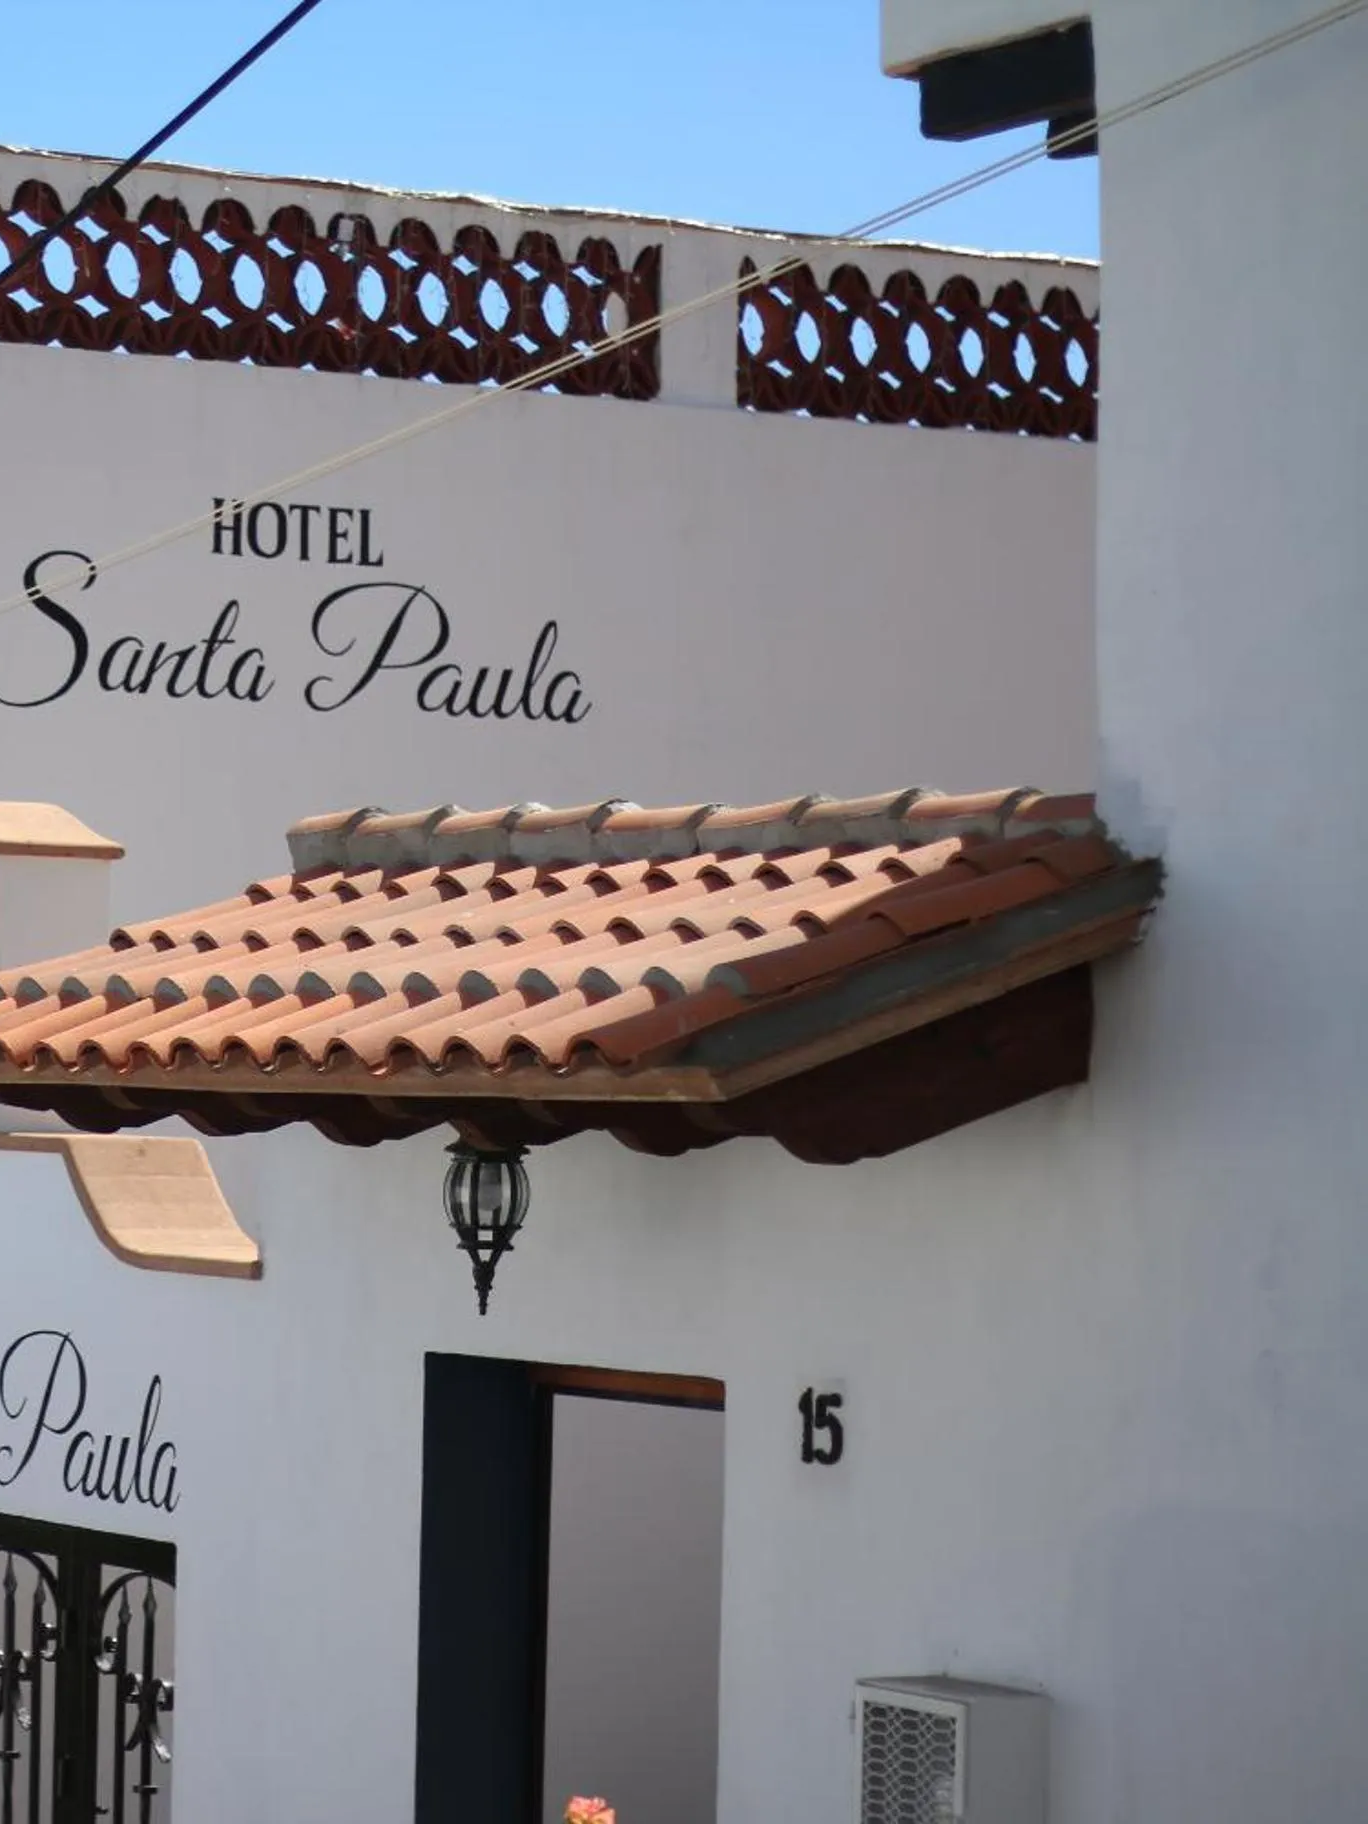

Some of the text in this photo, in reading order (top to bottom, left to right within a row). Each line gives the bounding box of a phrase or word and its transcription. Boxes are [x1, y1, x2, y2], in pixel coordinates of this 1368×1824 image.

[211, 497, 384, 567] HOTEL
[303, 582, 592, 724] Paula
[798, 1387, 843, 1465] 15
